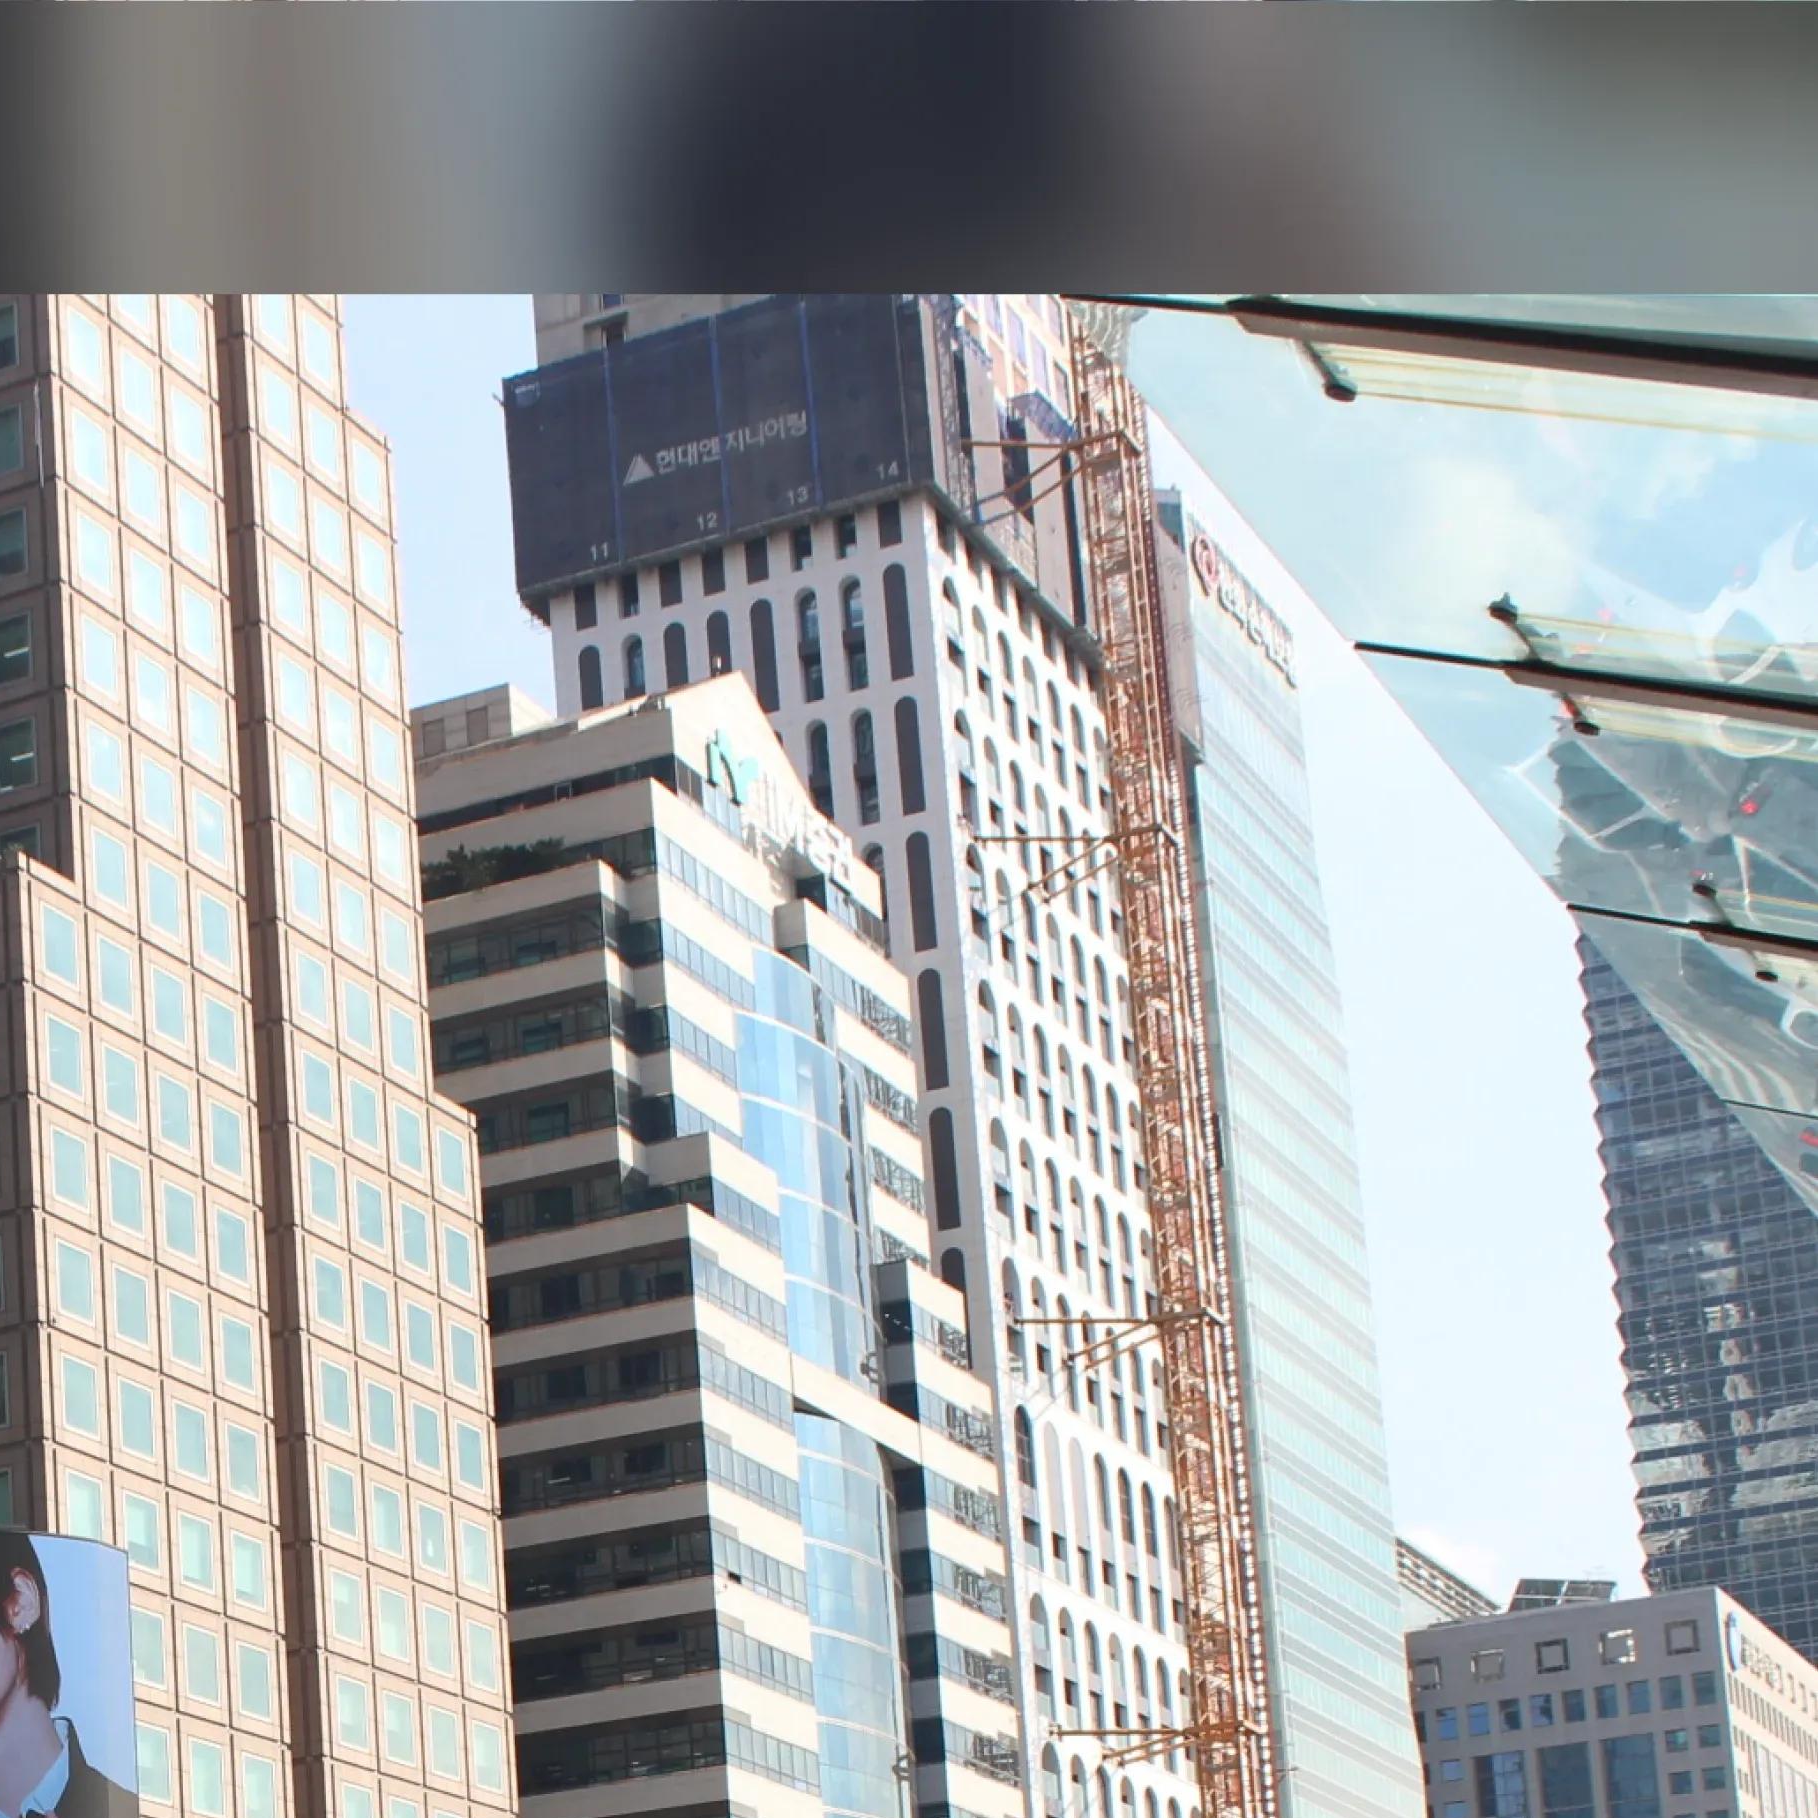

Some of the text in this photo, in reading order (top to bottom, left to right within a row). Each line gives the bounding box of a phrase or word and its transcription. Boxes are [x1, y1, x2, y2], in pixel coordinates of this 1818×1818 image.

[877, 460, 899, 480] 14
[786, 486, 808, 505] 13
[696, 512, 718, 531] 12
[589, 542, 610, 562] 11
